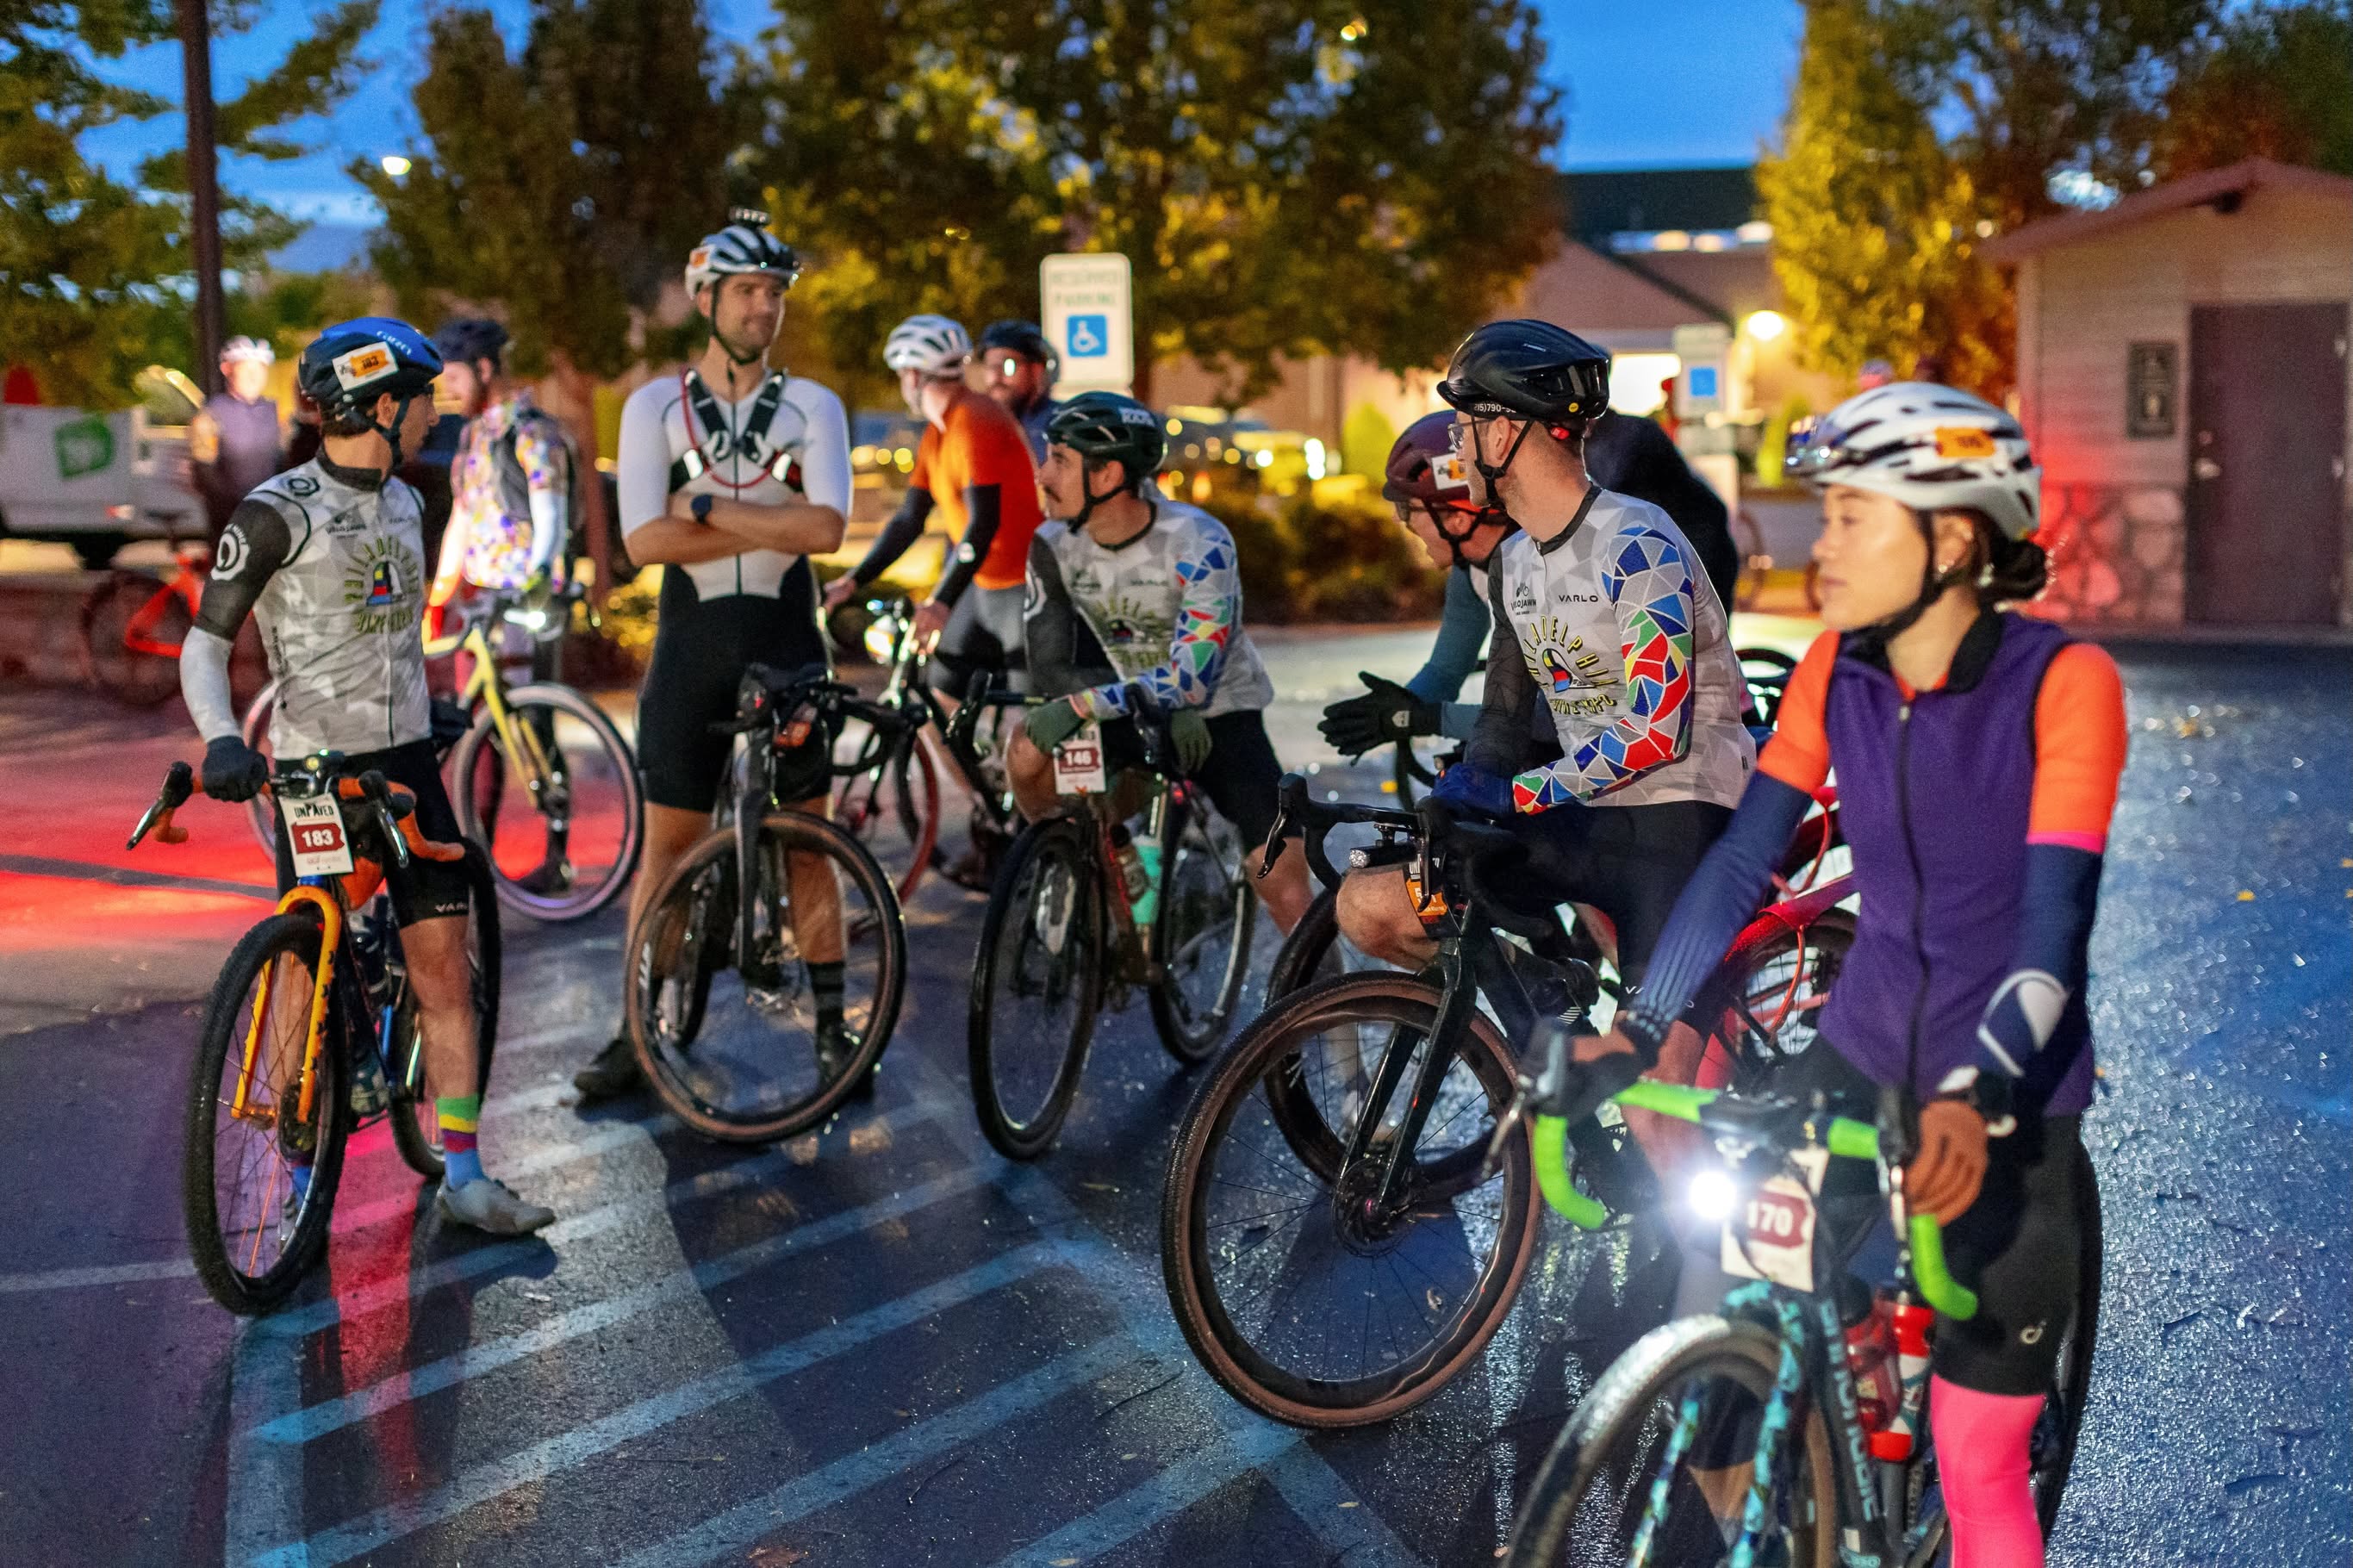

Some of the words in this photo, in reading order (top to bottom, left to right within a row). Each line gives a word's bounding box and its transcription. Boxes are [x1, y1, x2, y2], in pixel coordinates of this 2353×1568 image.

[1559, 594, 1599, 603] VARLO
[1523, 615, 1620, 688] HILADELPHIA
[294, 803, 334, 818] UNPAVED
[302, 829, 334, 848] 183
[1747, 1201, 1794, 1237] 170
